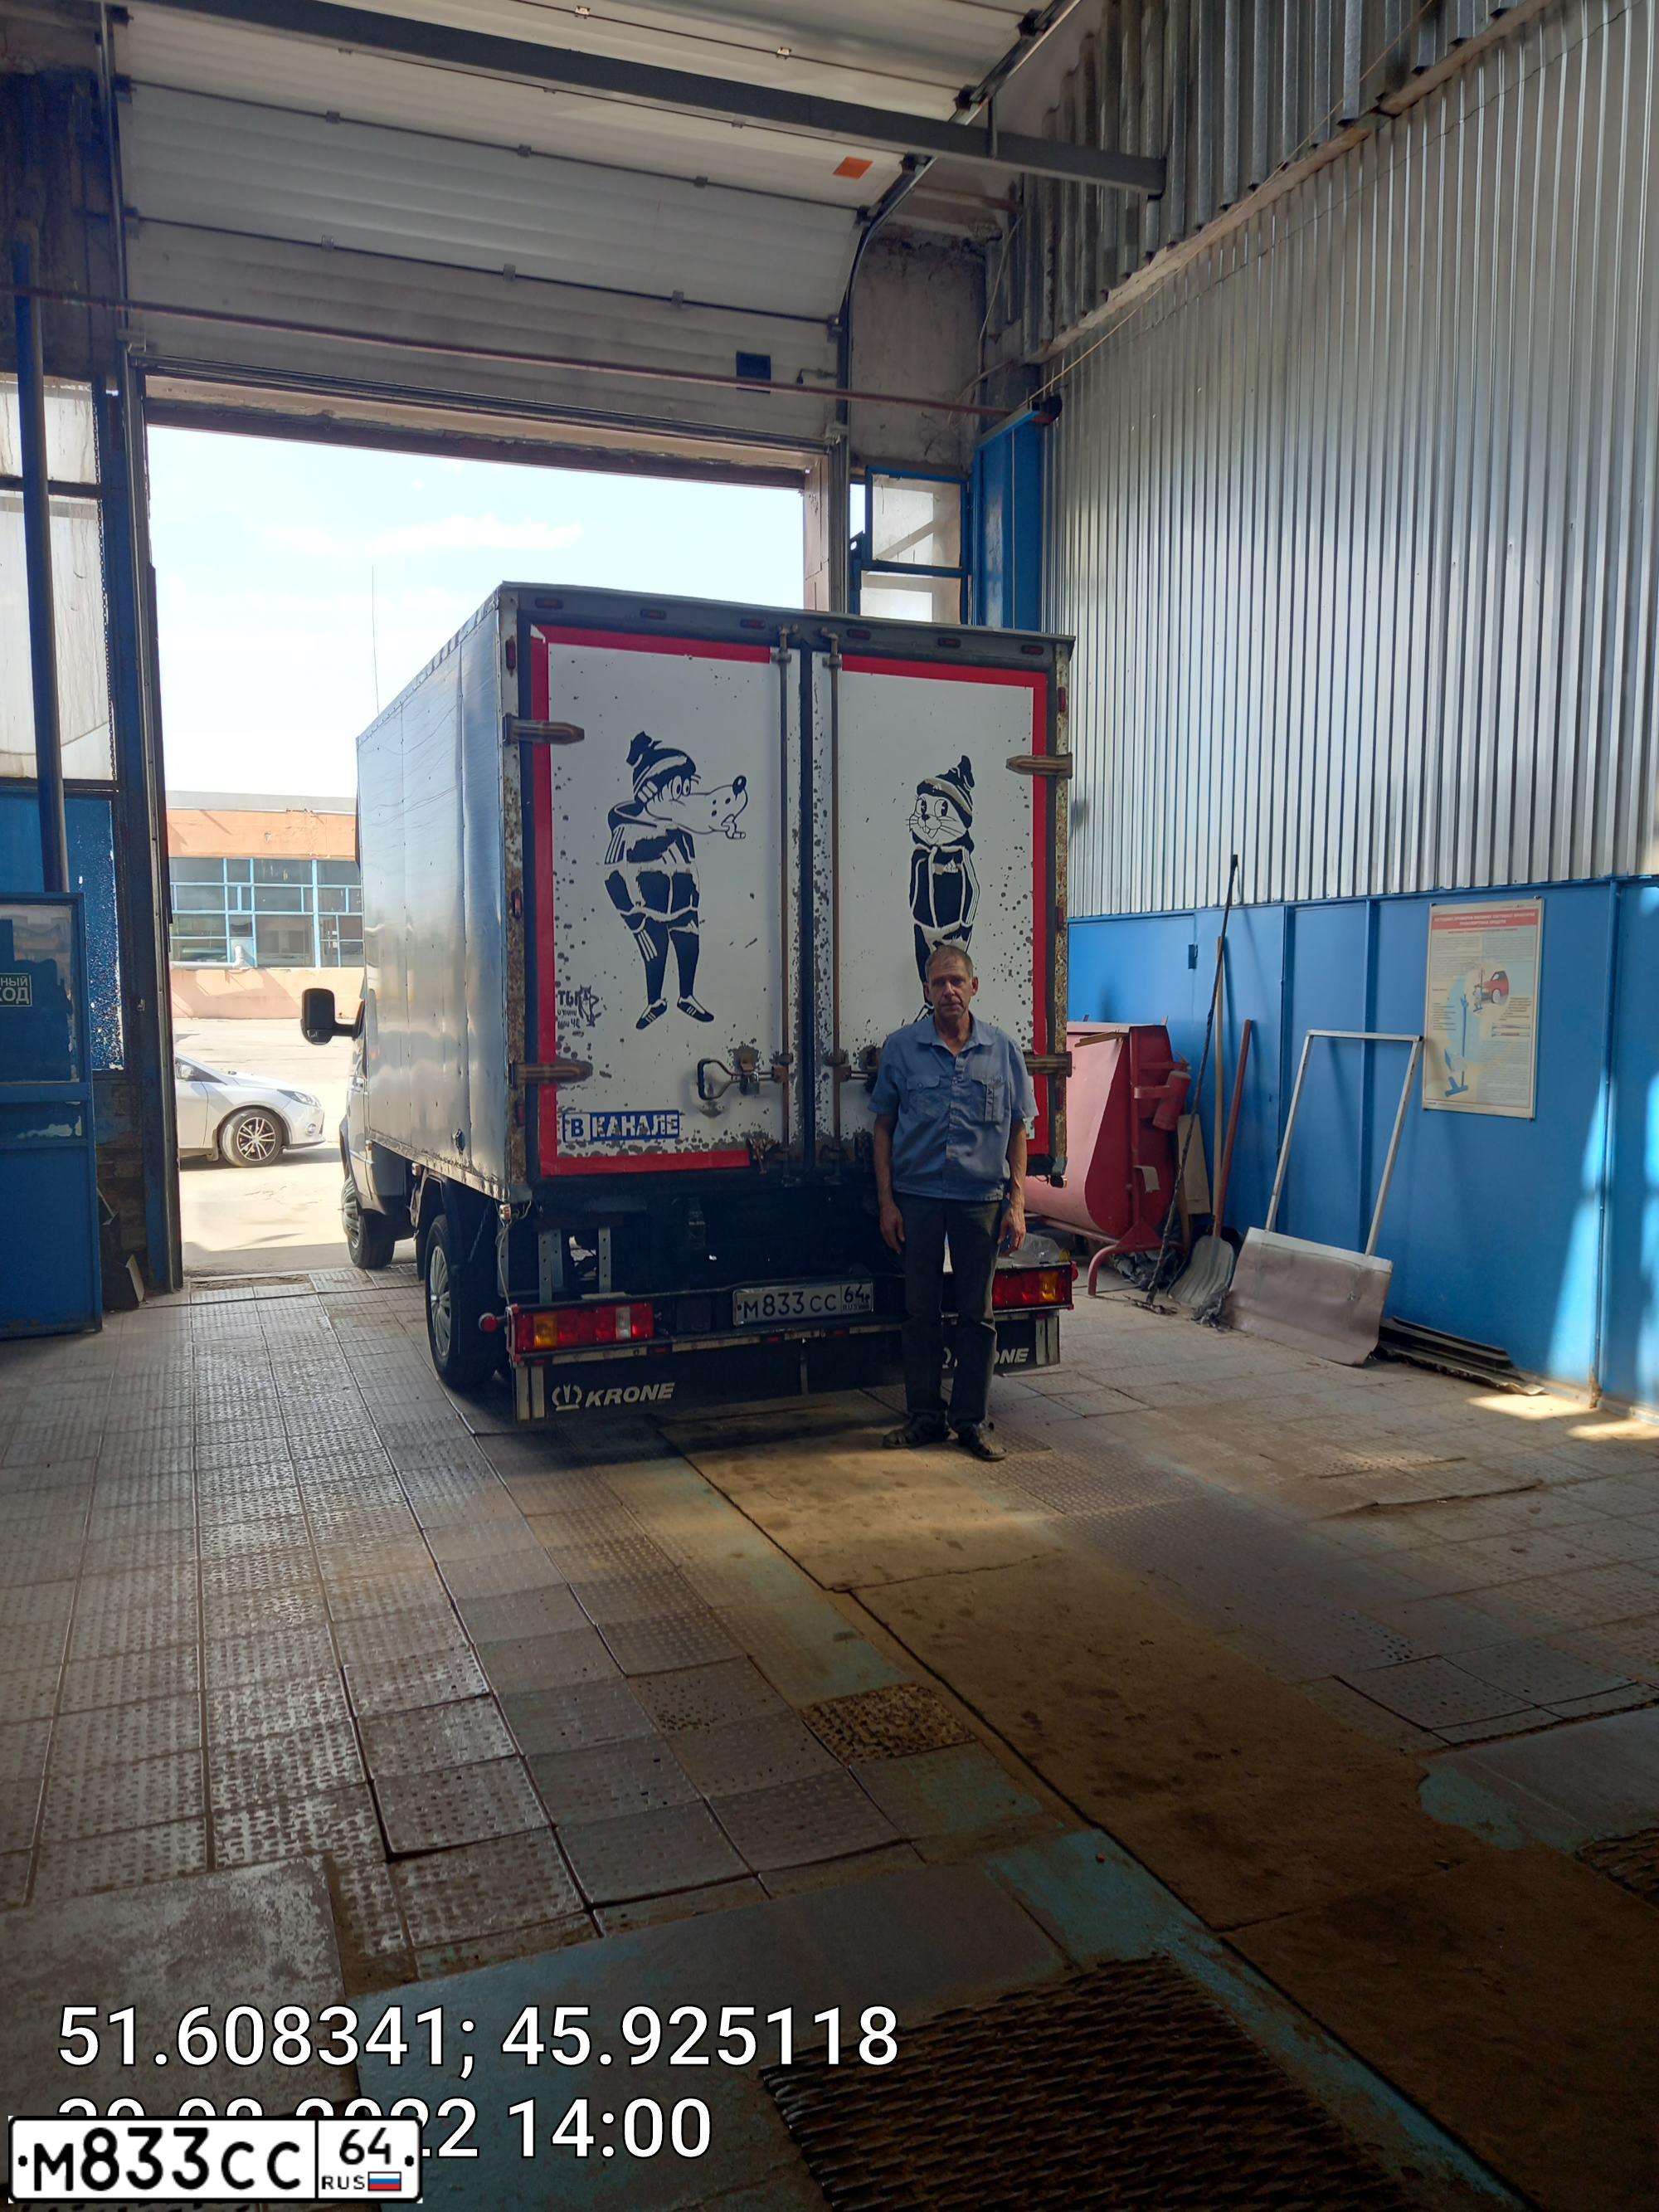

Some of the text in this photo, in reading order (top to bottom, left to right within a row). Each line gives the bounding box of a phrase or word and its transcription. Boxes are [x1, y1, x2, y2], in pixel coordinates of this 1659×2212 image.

[0, 987, 29, 1004] ОД
[571, 1113, 679, 1138] В КАНАЛЕ
[844, 1284, 865, 1303] 64
[585, 1382, 675, 1408] KRONE
